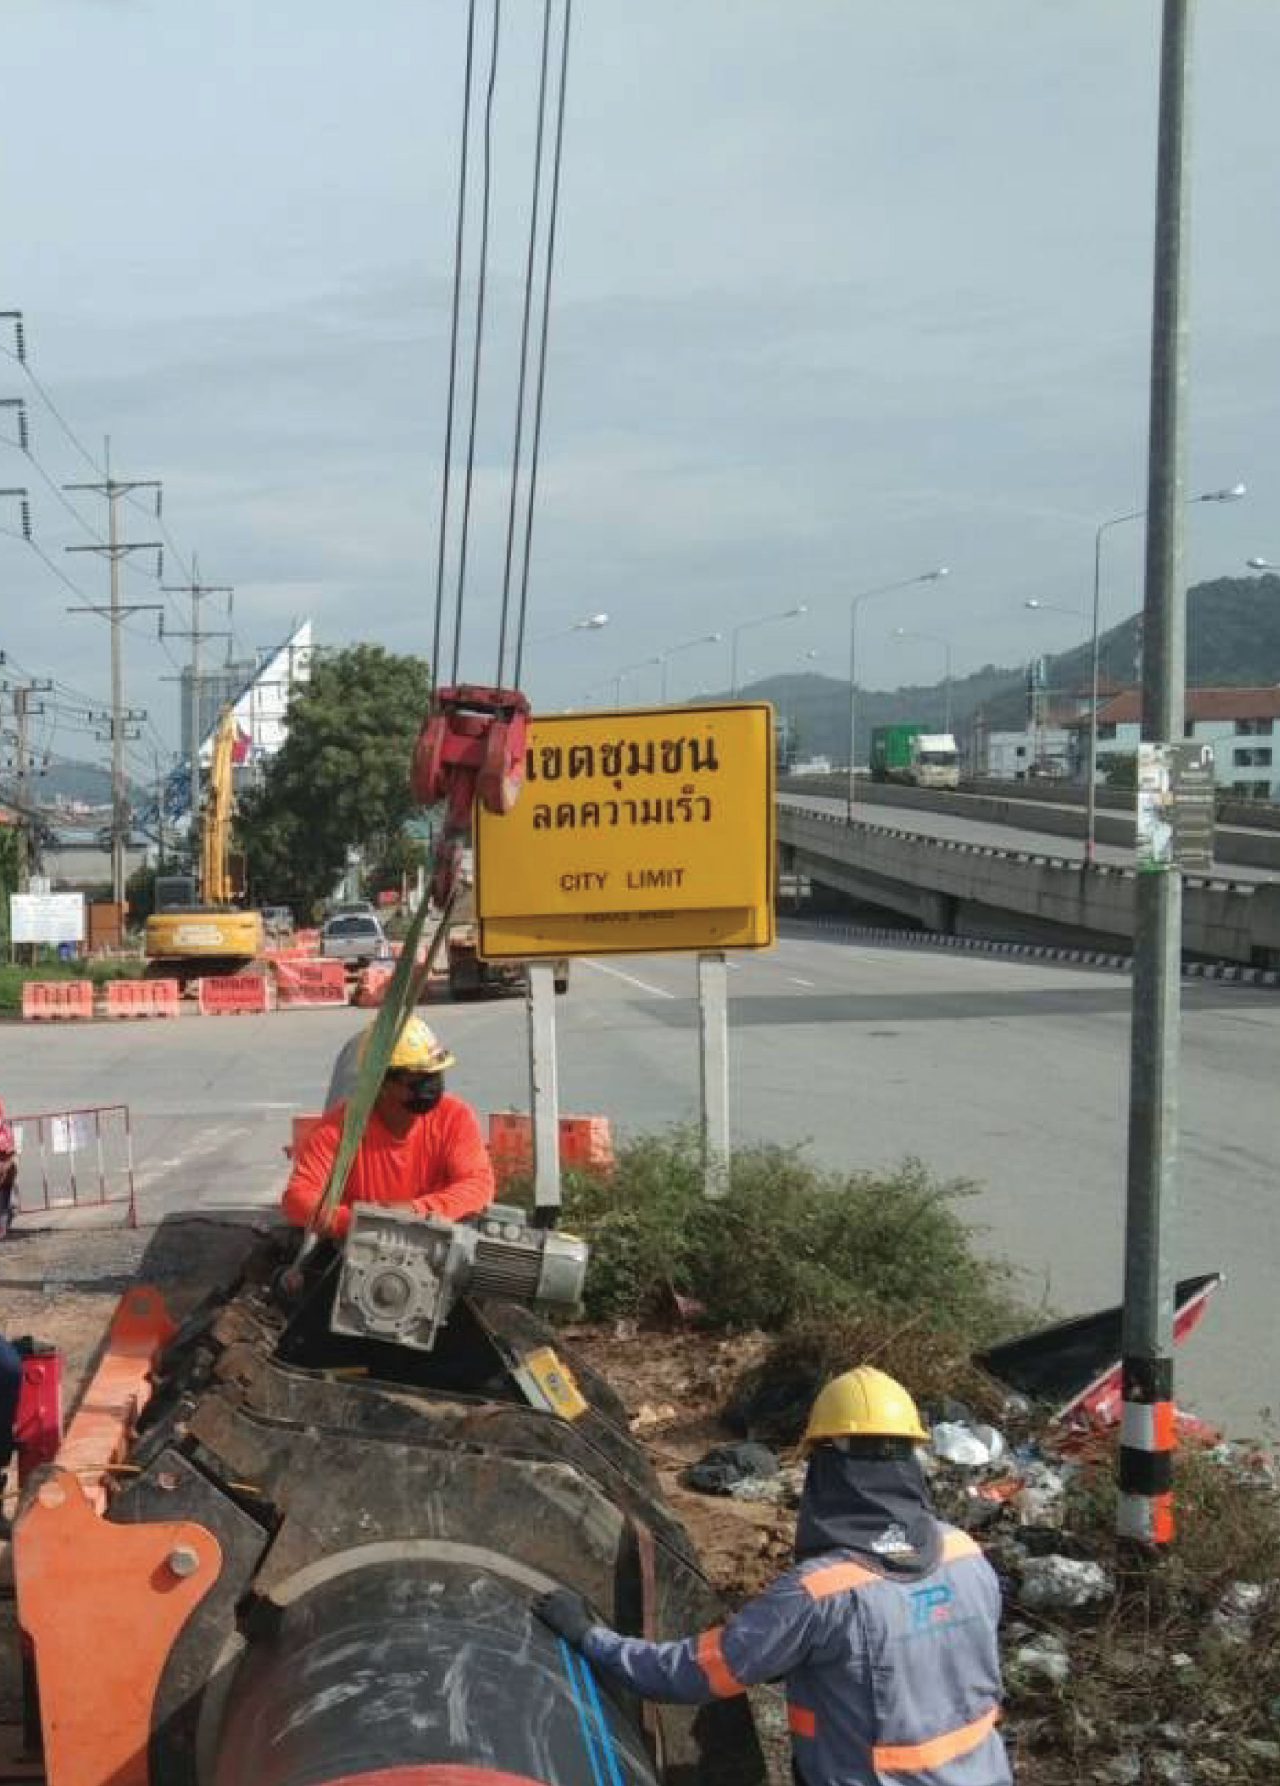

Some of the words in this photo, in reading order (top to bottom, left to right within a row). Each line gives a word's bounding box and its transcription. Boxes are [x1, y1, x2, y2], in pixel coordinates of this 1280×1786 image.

[526, 738, 719, 790] เขตชุมชน
[532, 785, 711, 829] ลดความเร็ว
[560, 873, 608, 892] CITY
[628, 869, 686, 890] LIMIT
